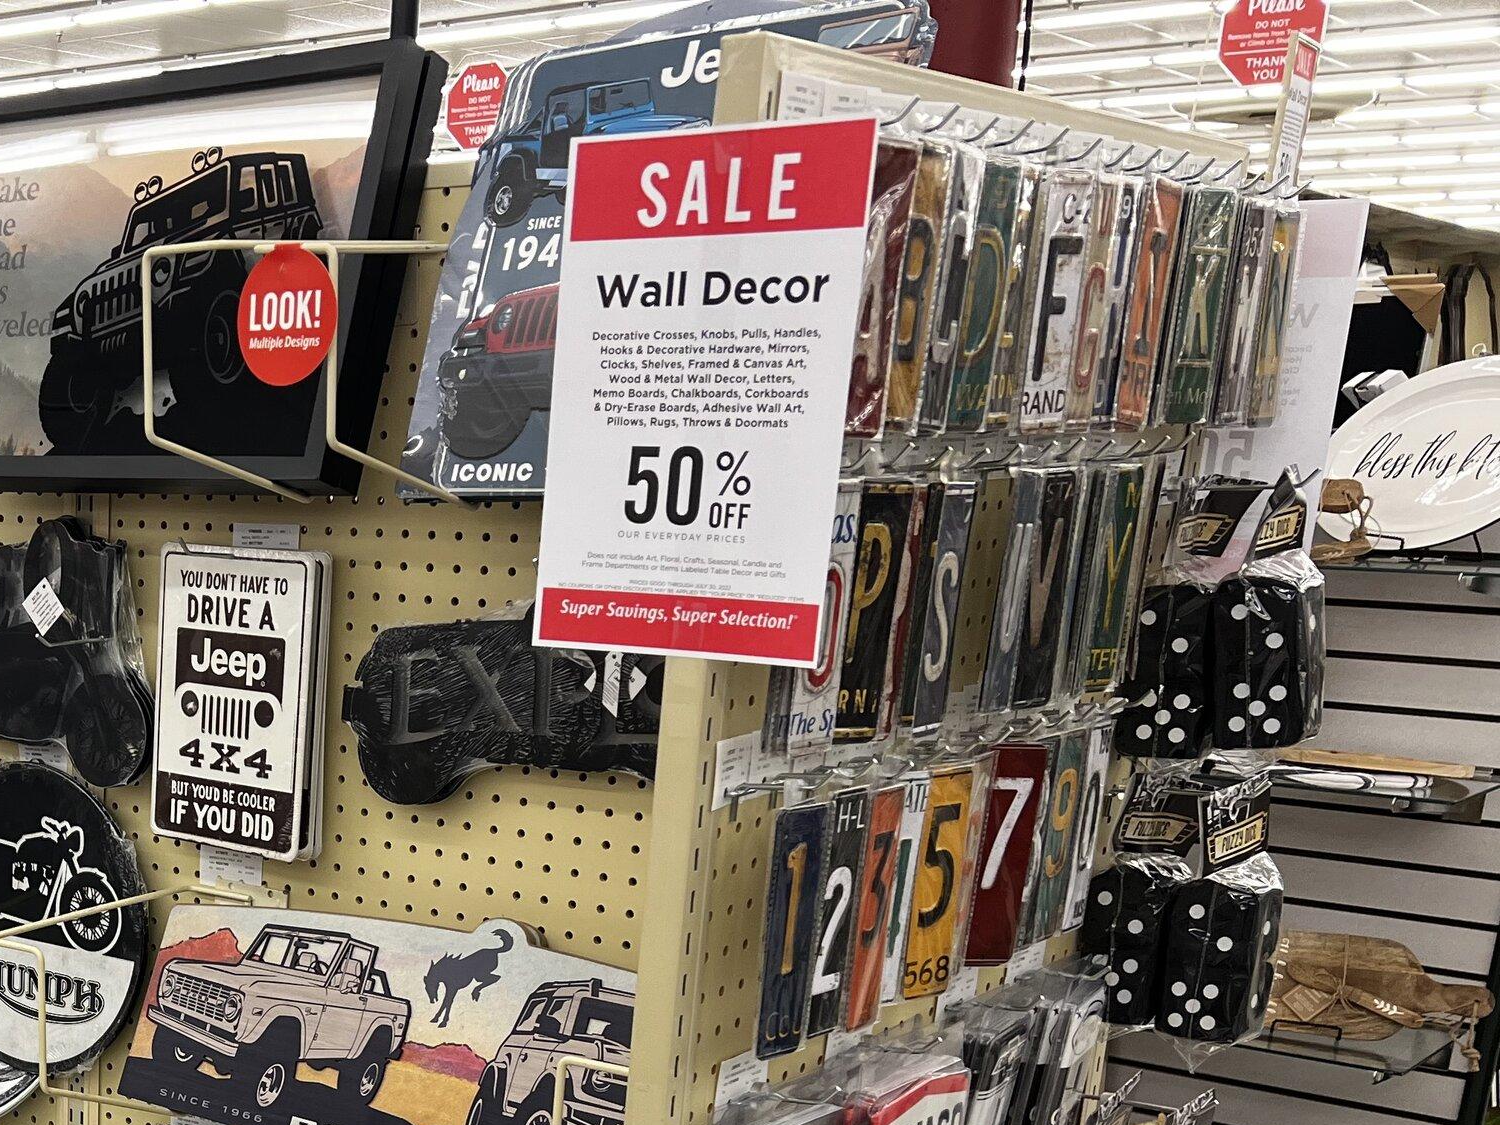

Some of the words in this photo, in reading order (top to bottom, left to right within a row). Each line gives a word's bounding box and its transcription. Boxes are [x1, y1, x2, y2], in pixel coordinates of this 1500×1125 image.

[1255, 20, 1269, 29] DO
[1271, 19, 1291, 28] NOT
[463, 74, 500, 94] Please
[1252, 69, 1278, 80] YOU
[637, 152, 802, 228] SALE
[526, 216, 563, 231] SINCE
[597, 271, 688, 309] Wall
[702, 271, 831, 307] Decor
[249, 290, 322, 332] LOOK!
[248, 335, 284, 351] Multiple
[285, 335, 320, 351] Designs
[592, 331, 650, 342] Decorative
[653, 330, 698, 342] Crosses,
[701, 329, 738, 341] Knobs,
[742, 328, 771, 340] Pulls,
[774, 327, 822, 340] Handles,
[600, 345, 634, 355] Hooks
[647, 344, 705, 355] Decorative
[709, 344, 765, 355] Hardware,
[768, 343, 810, 355] Mirrors,
[600, 359, 638, 371] Clocks,
[641, 359, 685, 371] Shelves,
[688, 359, 730, 369] Framed
[743, 359, 783, 369] Canvas
[786, 358, 807, 370] Art,
[609, 375, 641, 384] Wood
[654, 375, 684, 384] Metal
[687, 374, 712, 384] Wall
[714, 374, 750, 386] Decor,
[753, 374, 795, 386] Letters,
[593, 388, 626, 398] Memo
[628, 388, 668, 400] Boards,
[671, 388, 742, 400] Chalkboards,
[745, 388, 809, 398] Corkboards
[604, 403, 656, 415] Dry-Erase
[659, 403, 700, 415] Boards,
[702, 402, 752, 413] Adhesive
[756, 402, 781, 412] Wall
[785, 402, 805, 414] Art,
[606, 417, 647, 429] Pillows,
[650, 417, 679, 430] Rugs,
[682, 417, 721, 428] Throws
[735, 417, 789, 428] Doormats
[450, 462, 534, 483] ICONIC
[709, 502, 751, 530] OFF
[617, 530, 640, 539] OUR
[644, 531, 702, 543] EVERYDAY
[706, 534, 746, 544] PRICES
[181, 570, 204, 589] YOU
[205, 572, 237, 592] DON'T
[240, 575, 270, 594] HAVE
[273, 577, 288, 596] TO
[187, 594, 251, 629] DRIVE
[259, 600, 276, 631] A
[560, 599, 603, 619] Super
[606, 602, 669, 623] Savings,
[672, 606, 717, 627] Super
[720, 611, 794, 630] Selection!
[191, 637, 267, 687] Jeep
[179, 738, 273, 780] 4X4
[171, 779, 189, 798] BUT
[222, 787, 235, 805] BE
[237, 790, 276, 812] COOLER
[169, 798, 187, 825] IF
[193, 802, 235, 834] YOU
[241, 811, 274, 842] DID
[981, 777, 1034, 890] 7
[159, 1088, 213, 1111] SINCE
[221, 1106, 264, 1124] 1966
